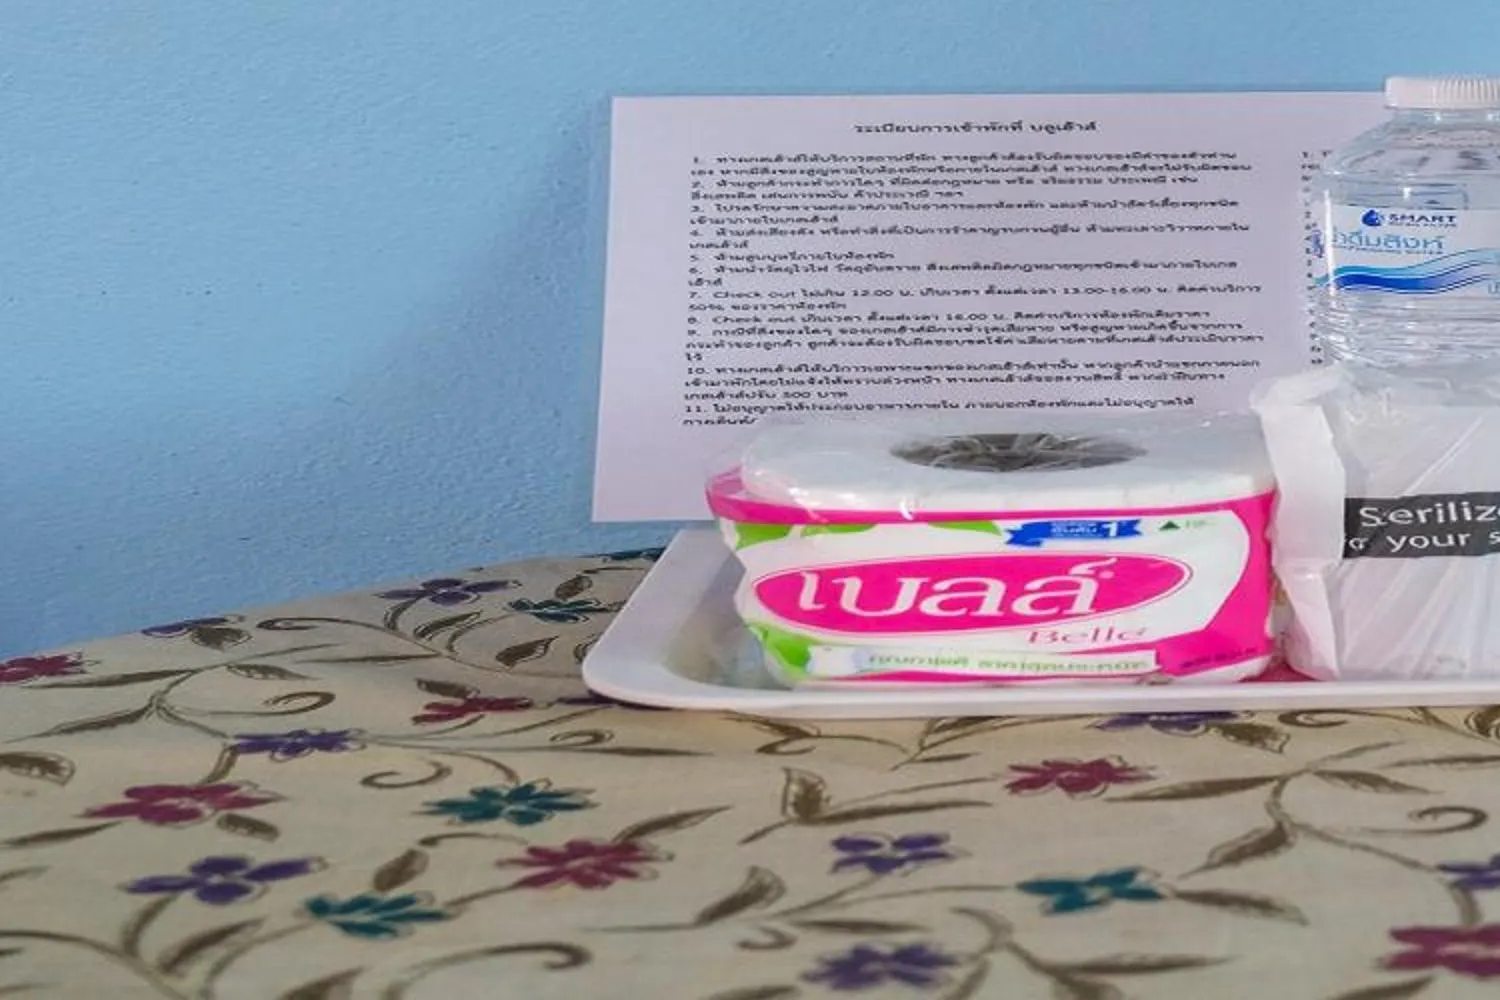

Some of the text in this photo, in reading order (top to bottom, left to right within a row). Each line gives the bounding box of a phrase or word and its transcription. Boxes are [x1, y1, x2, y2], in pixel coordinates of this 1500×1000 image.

[1389, 214, 1457, 223] SMART
[1386, 531, 1472, 553] your
[798, 557, 1119, 618] เบลล์
